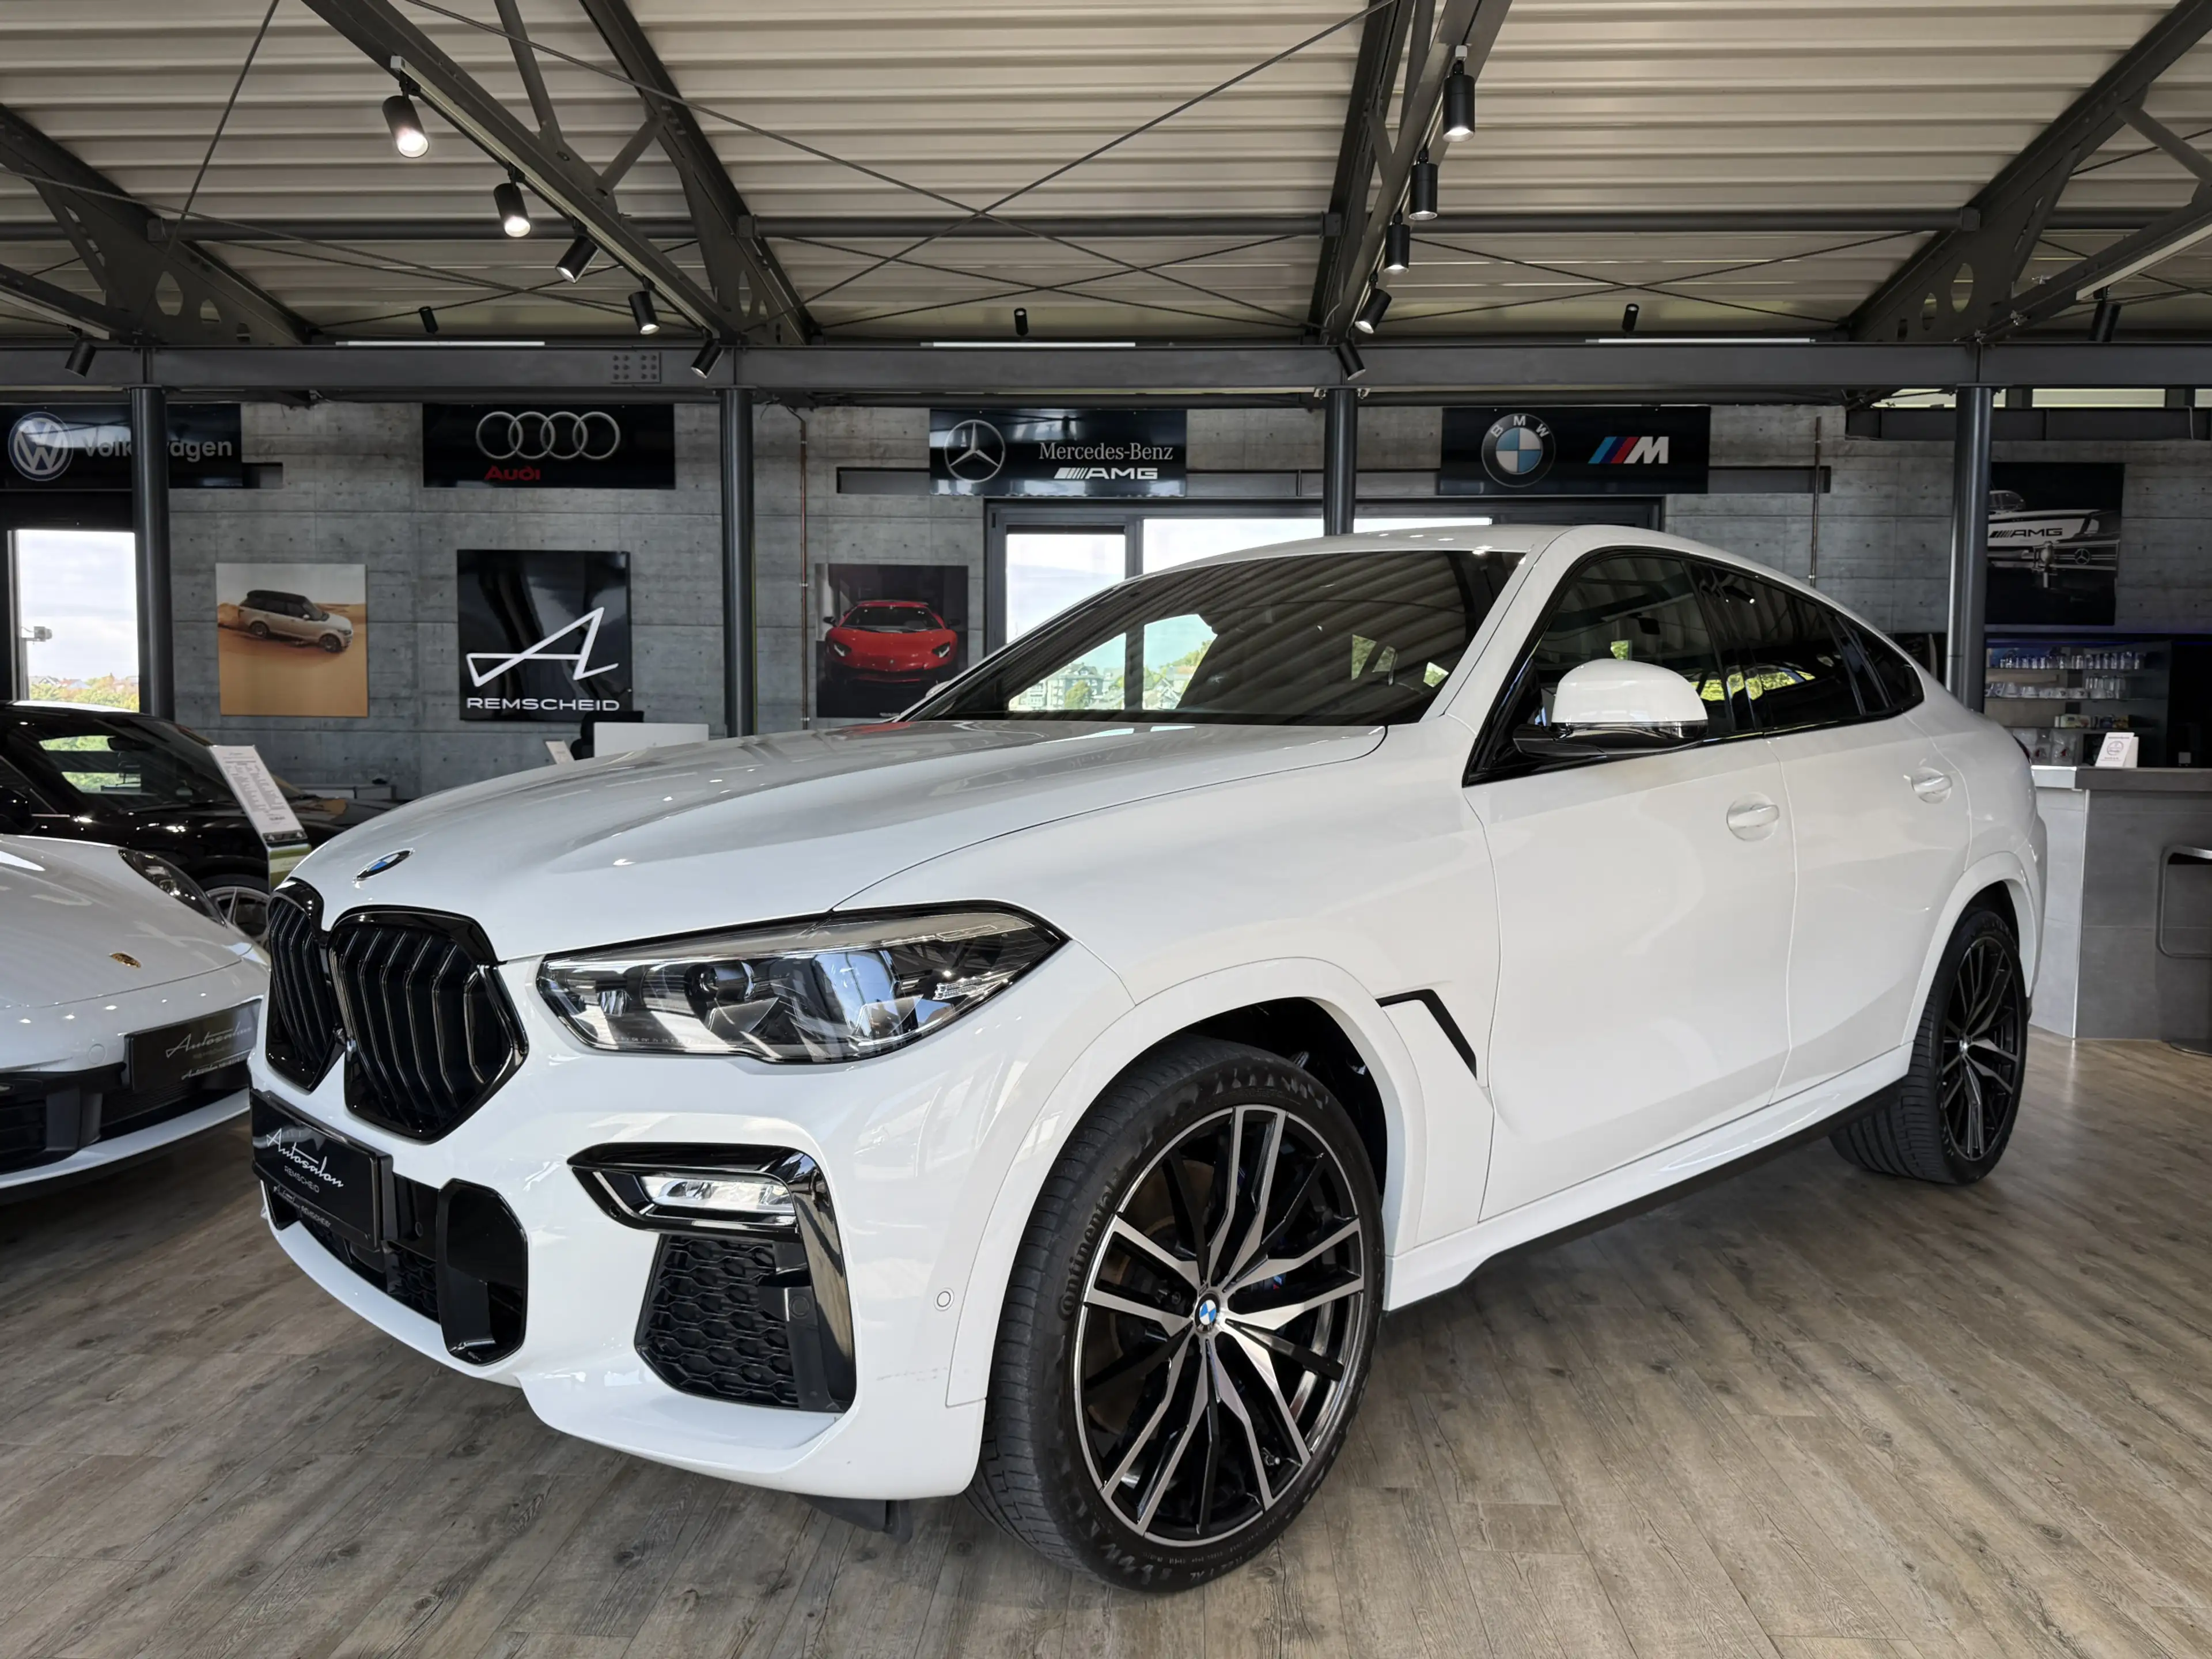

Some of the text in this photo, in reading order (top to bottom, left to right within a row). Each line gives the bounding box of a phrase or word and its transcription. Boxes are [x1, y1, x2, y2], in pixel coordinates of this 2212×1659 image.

[1490, 414, 1550, 439] BMW
[82, 436, 232, 463] Volkagen
[1038, 442, 1174, 460] Mercedes-Benz
[1085, 467, 1158, 479] AMG
[2010, 528, 2063, 537] AMG
[467, 697, 620, 711] REMSCHEID
[266, 1127, 344, 1188] Autosalon
